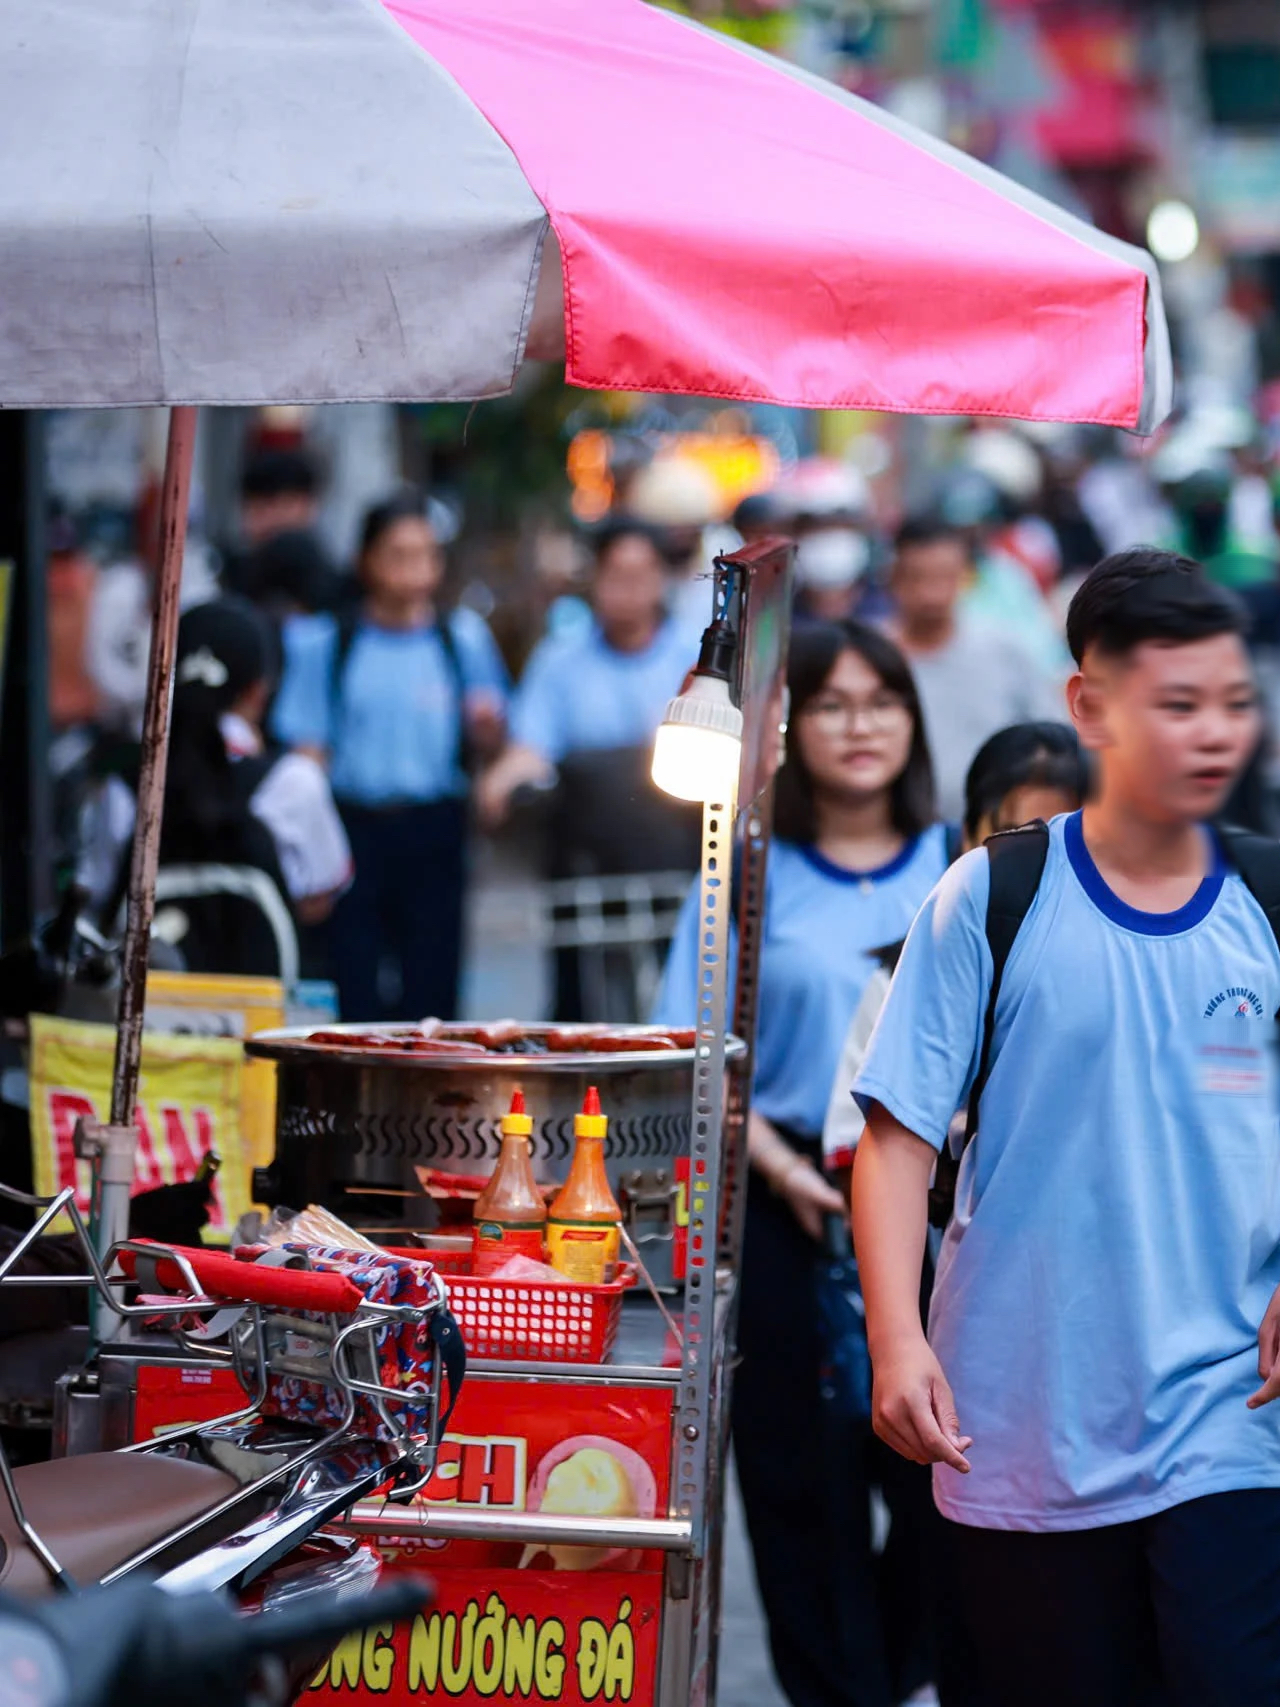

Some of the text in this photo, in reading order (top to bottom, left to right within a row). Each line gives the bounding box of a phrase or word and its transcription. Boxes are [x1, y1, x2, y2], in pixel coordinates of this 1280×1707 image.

[308, 1594, 635, 1700] NG NƯỚNG ĐÁ
